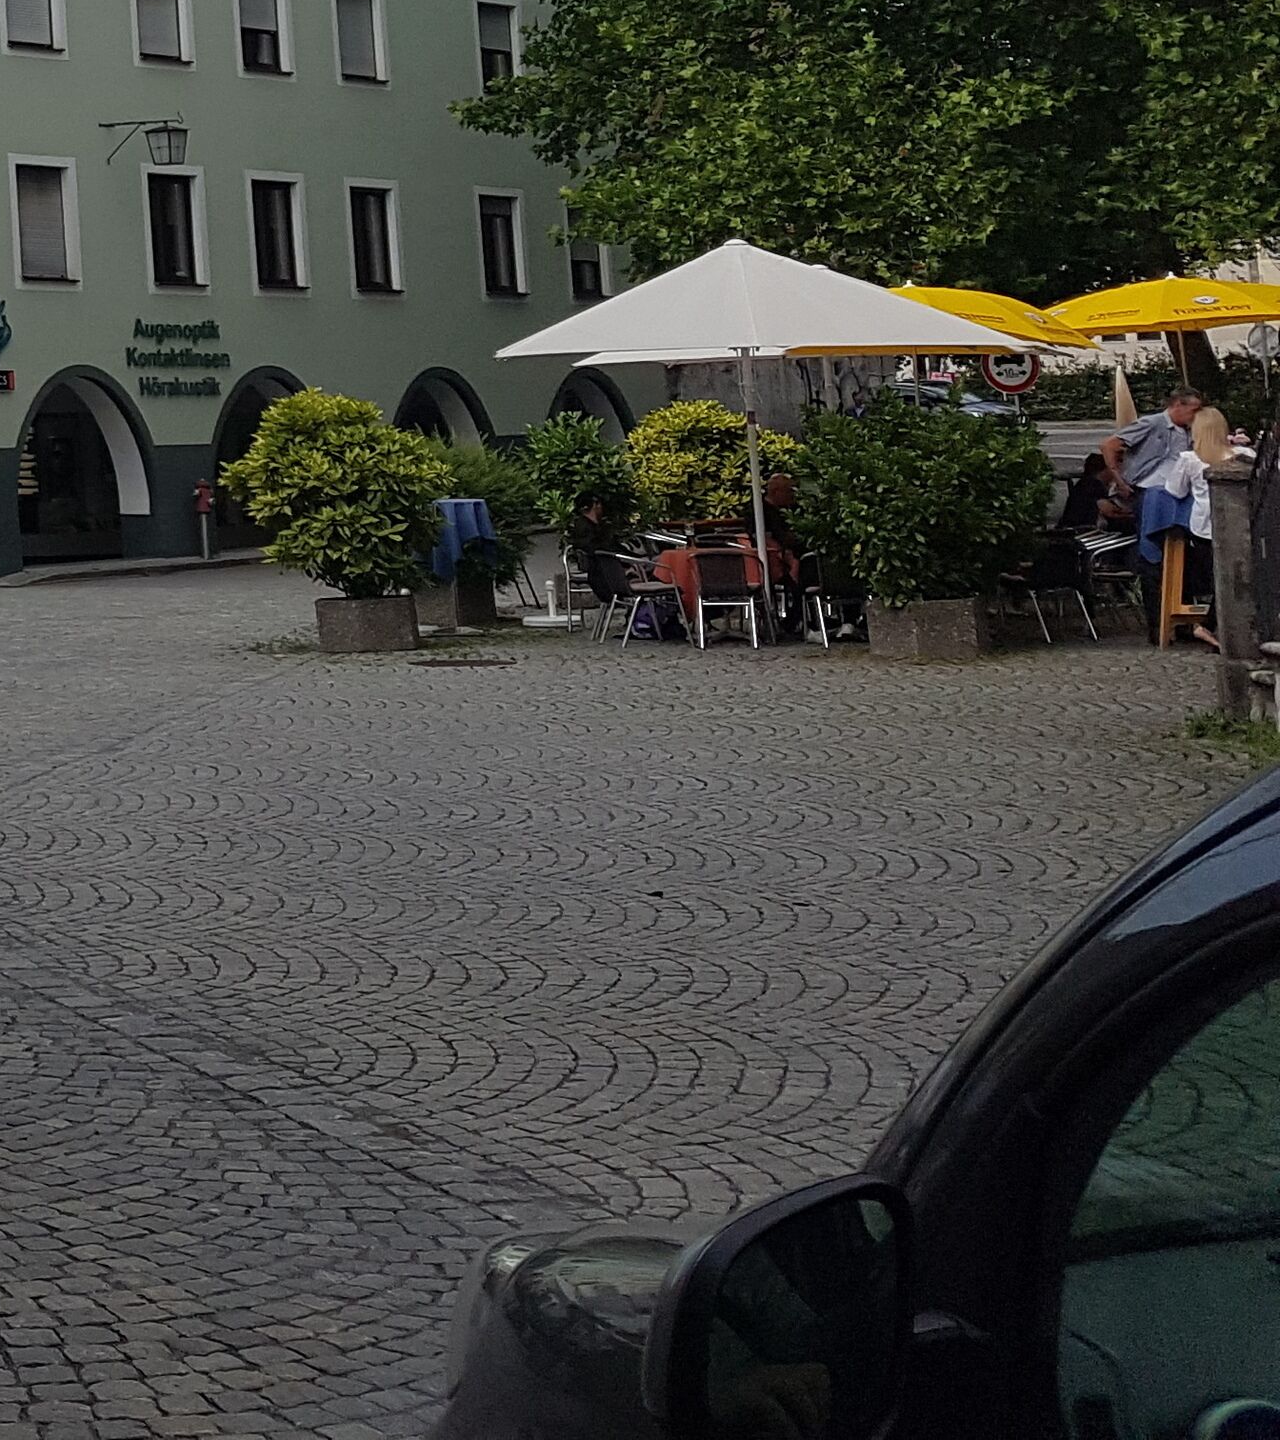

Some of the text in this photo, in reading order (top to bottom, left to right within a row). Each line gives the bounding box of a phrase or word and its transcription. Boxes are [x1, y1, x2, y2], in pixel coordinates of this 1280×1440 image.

[133, 318, 220, 345] Augenoptik
[125, 347, 230, 369] Kontaktlinsen
[138, 376, 221, 397] Hörakustik
